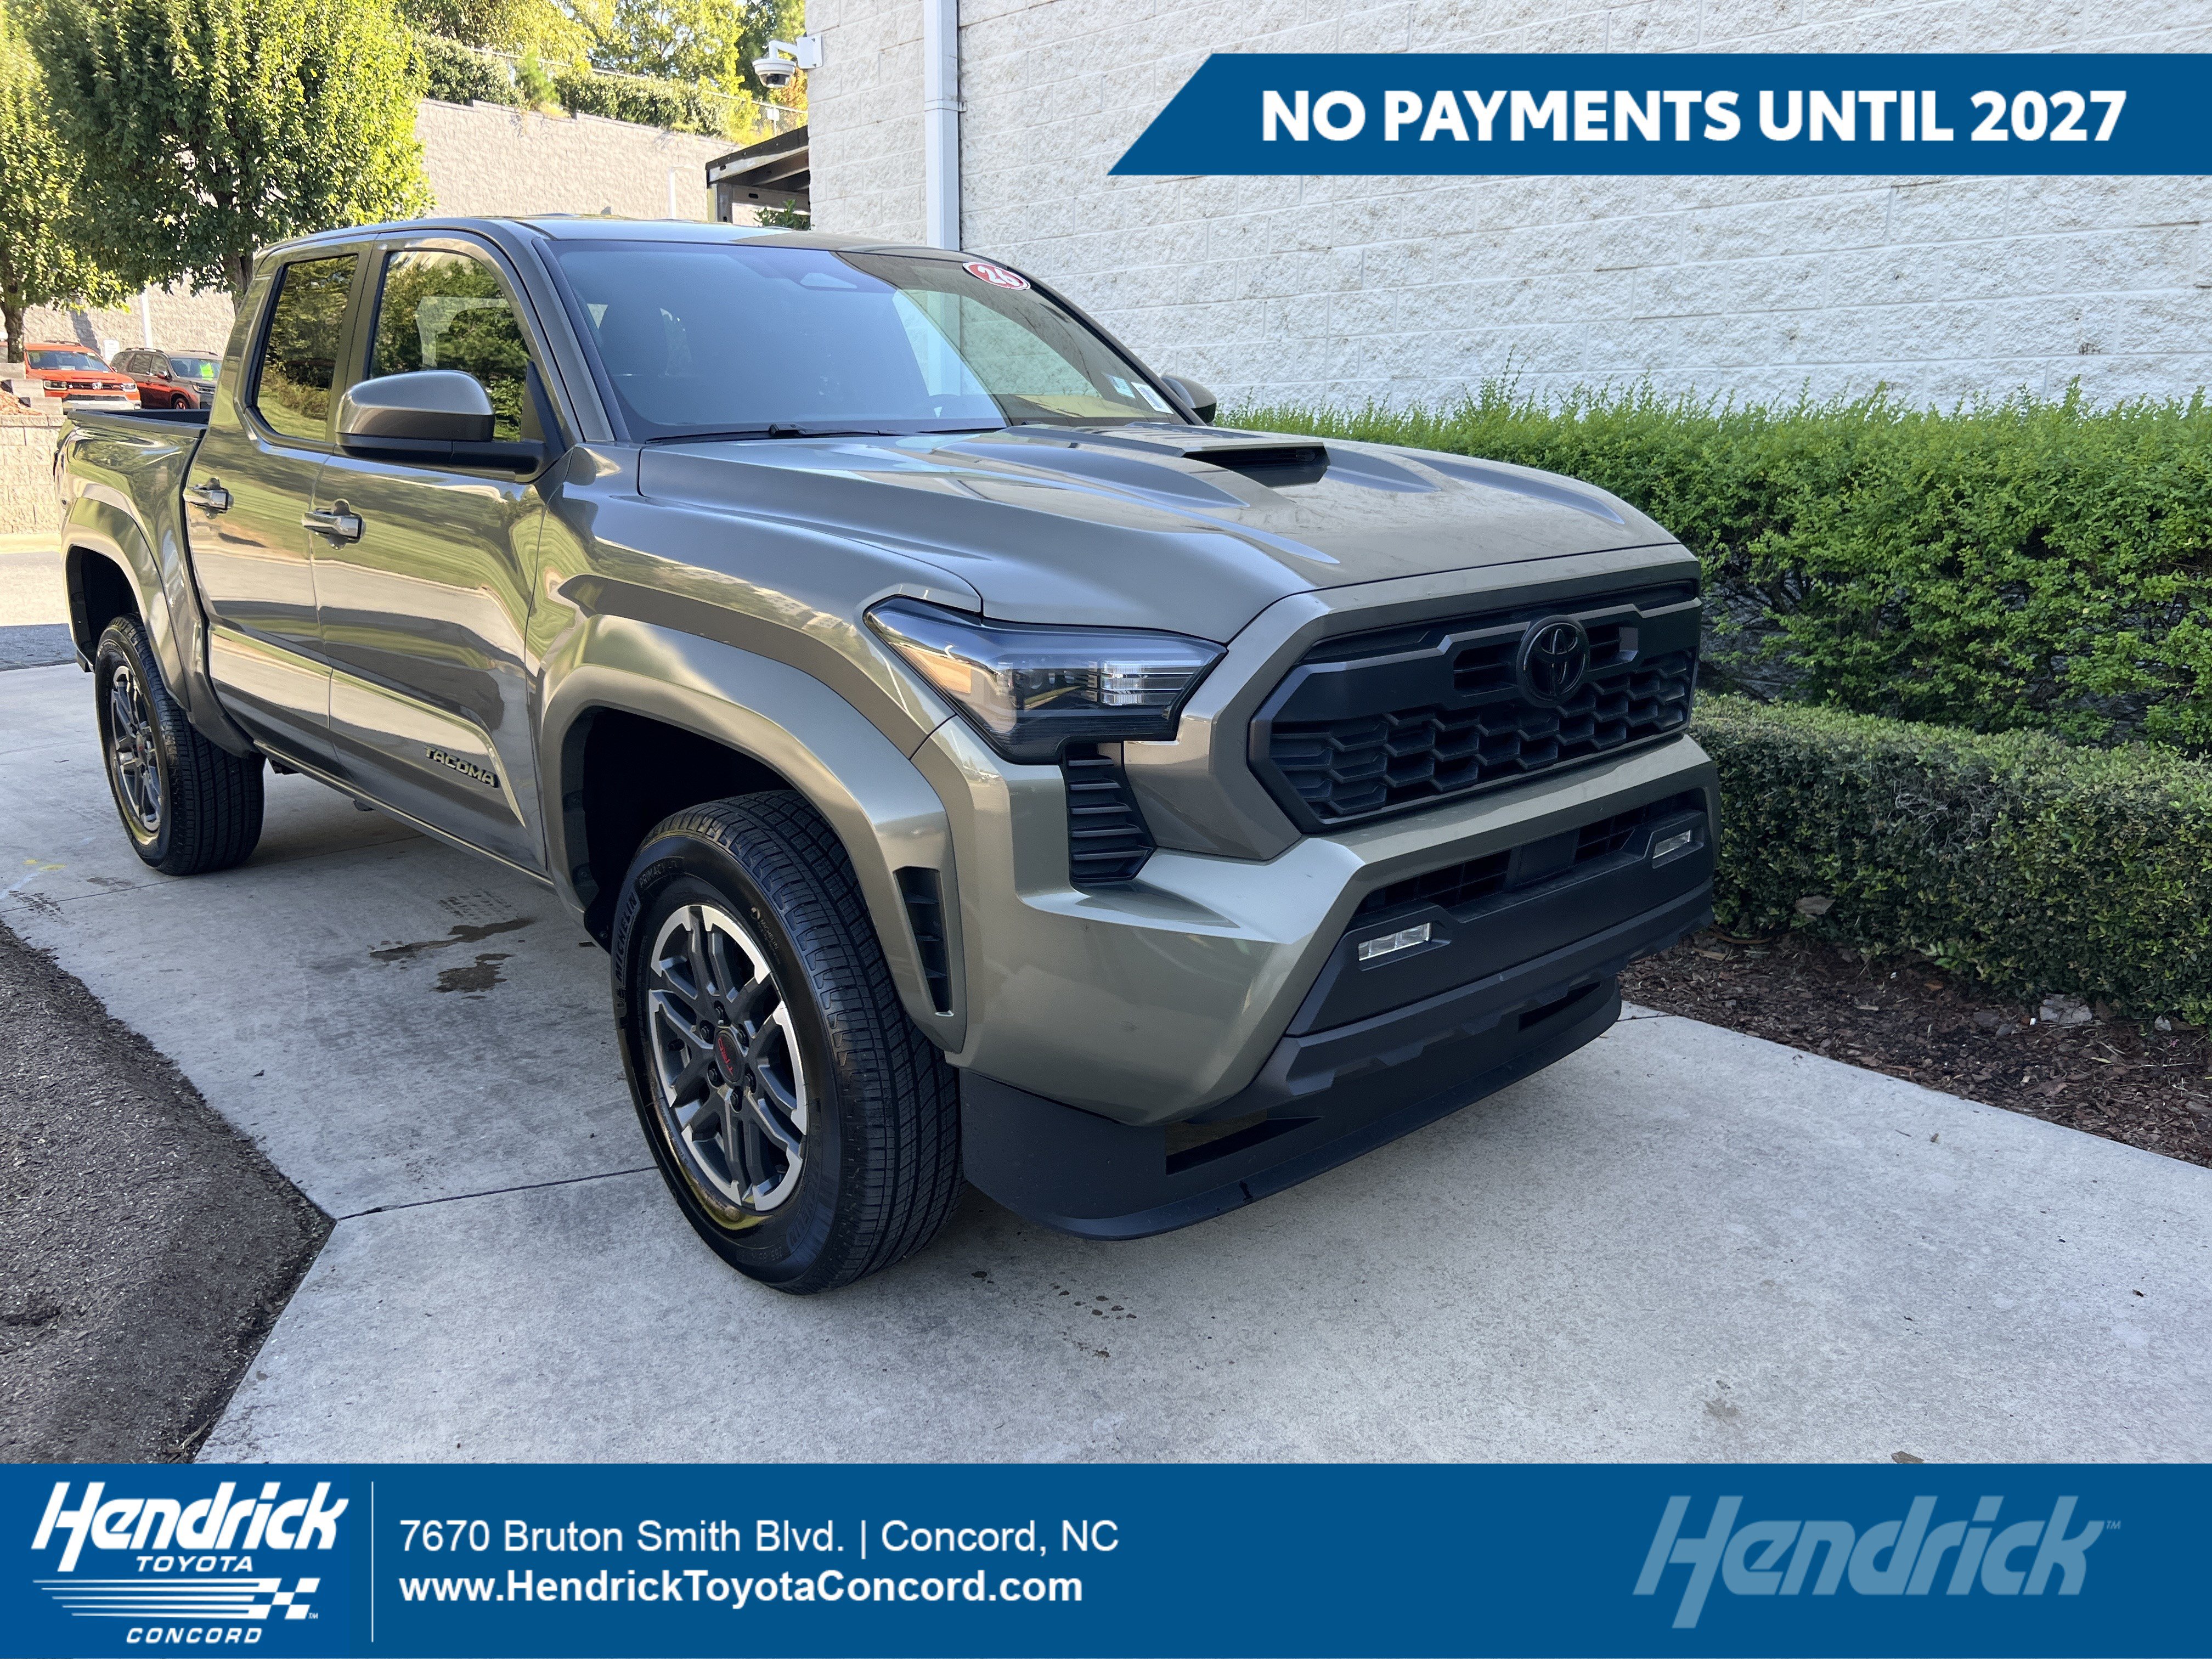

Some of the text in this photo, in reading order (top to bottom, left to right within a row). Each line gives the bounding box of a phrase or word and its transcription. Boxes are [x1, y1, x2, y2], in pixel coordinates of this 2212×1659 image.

[977, 266, 1021, 286] 26
[424, 745, 499, 788] TACOMA
[615, 891, 638, 983] MICHELIN
[718, 1036, 733, 1076] TRD
